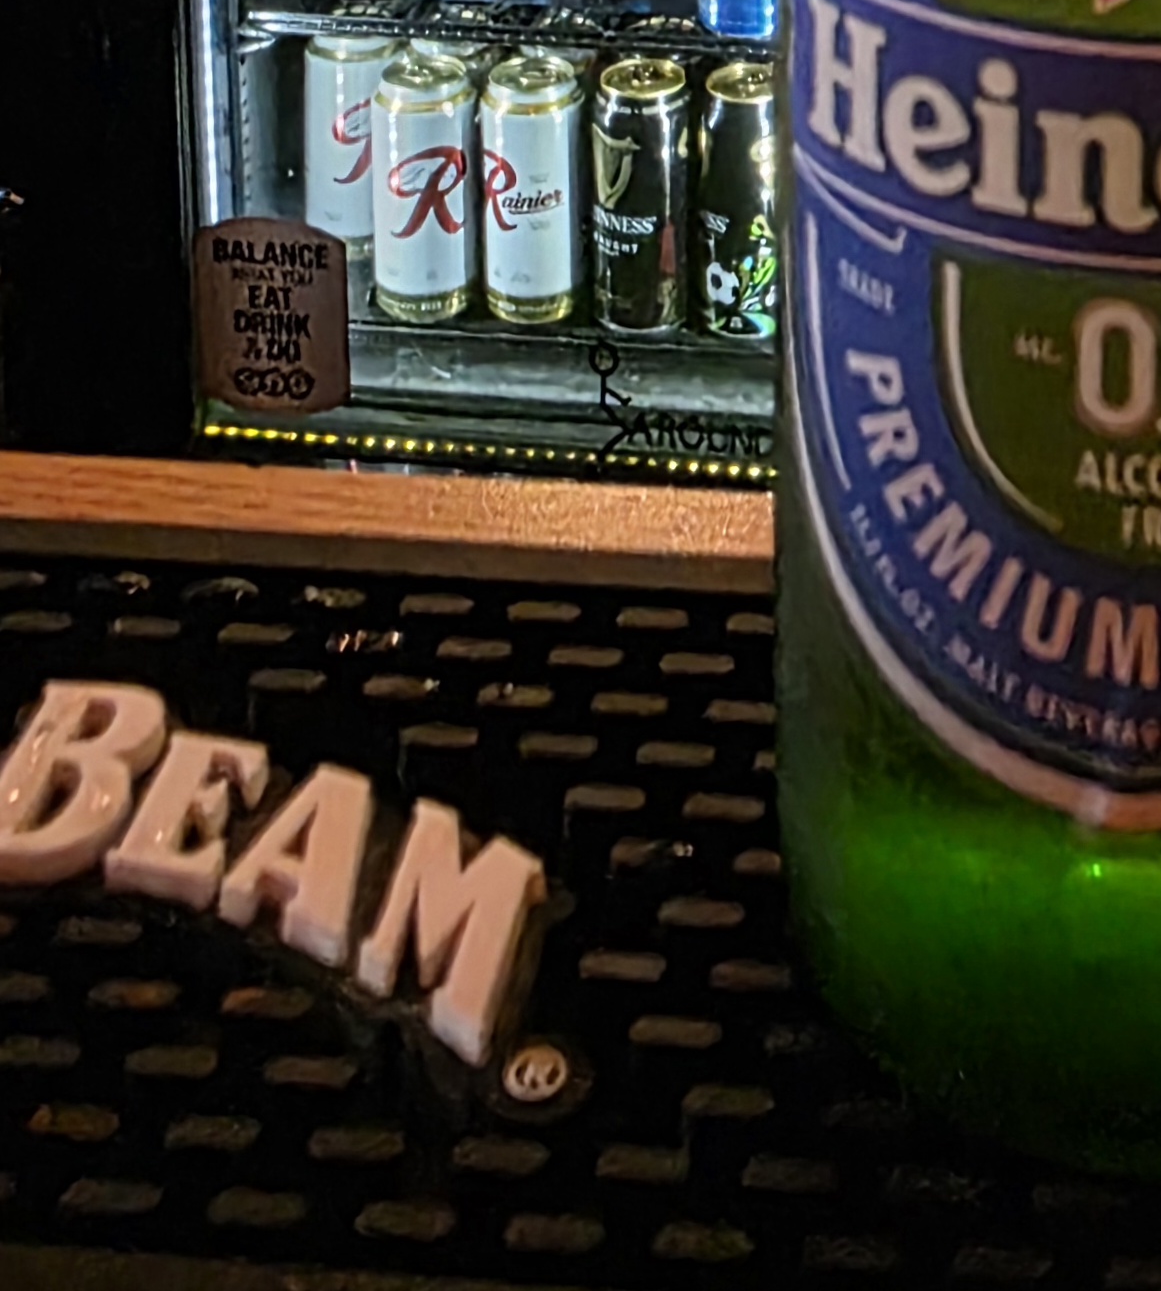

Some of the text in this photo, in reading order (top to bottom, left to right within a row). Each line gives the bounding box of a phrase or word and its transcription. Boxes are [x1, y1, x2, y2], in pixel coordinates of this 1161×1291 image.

[212, 237, 329, 269] BALANCE
[247, 284, 292, 310] EAT
[233, 309, 311, 339] DRINK
[627, 411, 774, 456] AROUND
[845, 347, 1161, 691] PREMIUM
[0, 679, 547, 1068] BEAM
